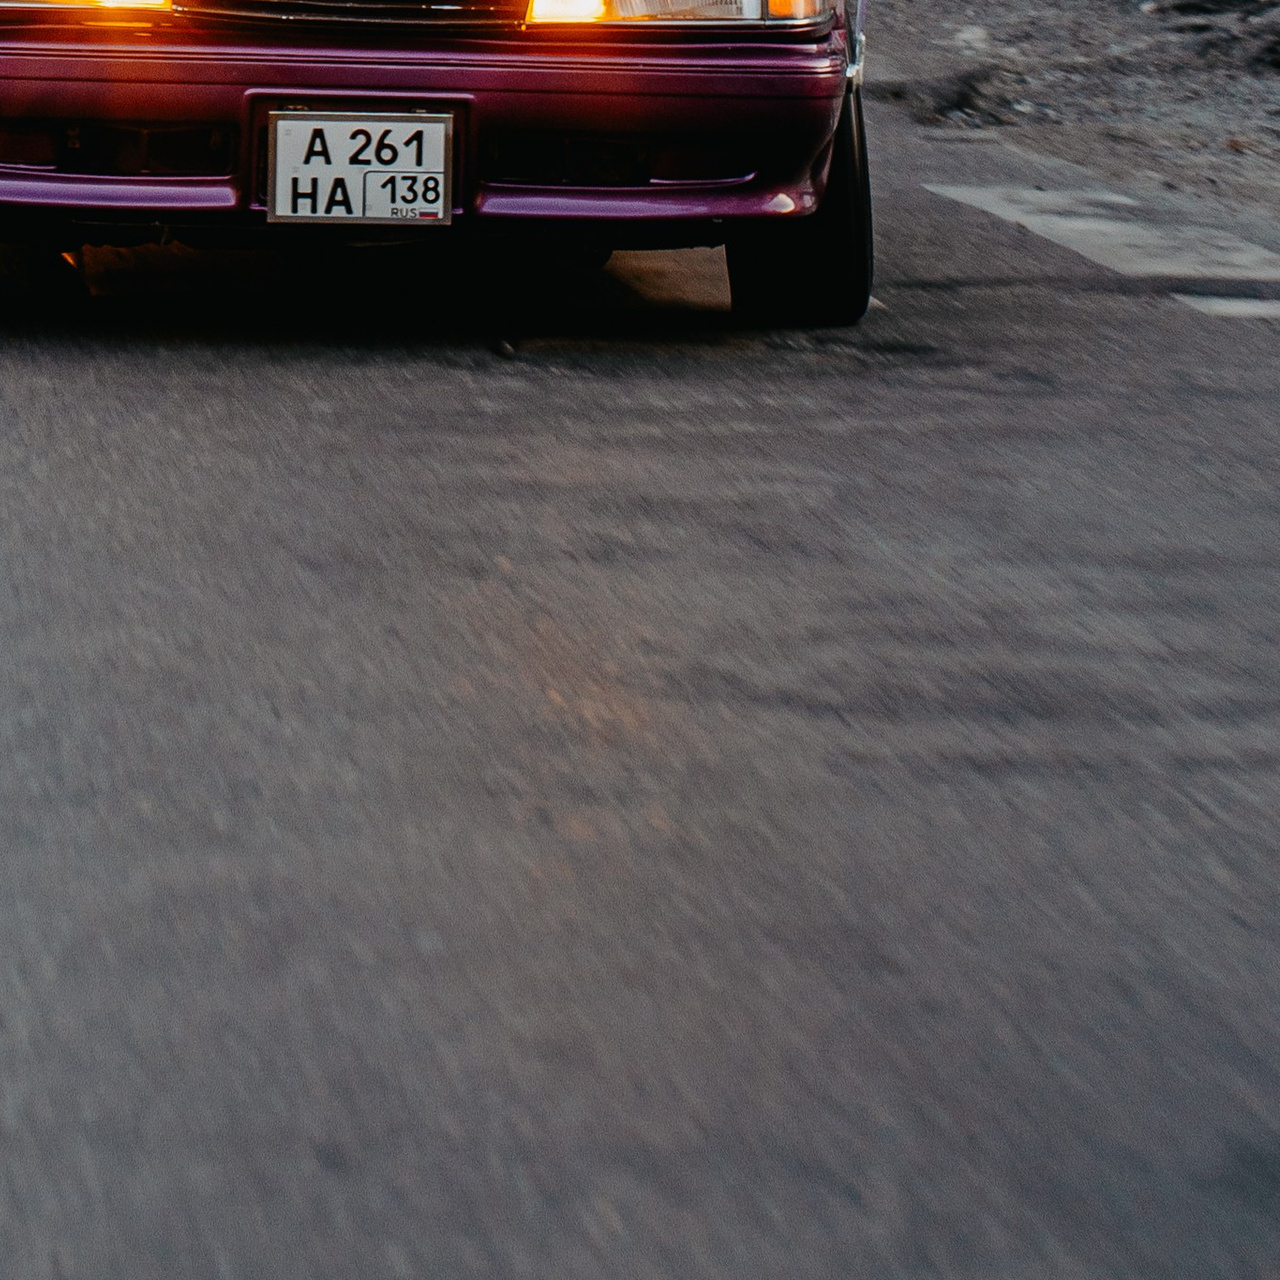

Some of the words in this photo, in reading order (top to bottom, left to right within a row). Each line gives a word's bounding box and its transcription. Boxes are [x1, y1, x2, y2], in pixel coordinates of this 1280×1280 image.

[303, 128, 332, 165] А
[349, 129, 424, 167] 261
[291, 177, 353, 215] НА
[380, 175, 440, 204] 138
[391, 207, 417, 218] RUS
